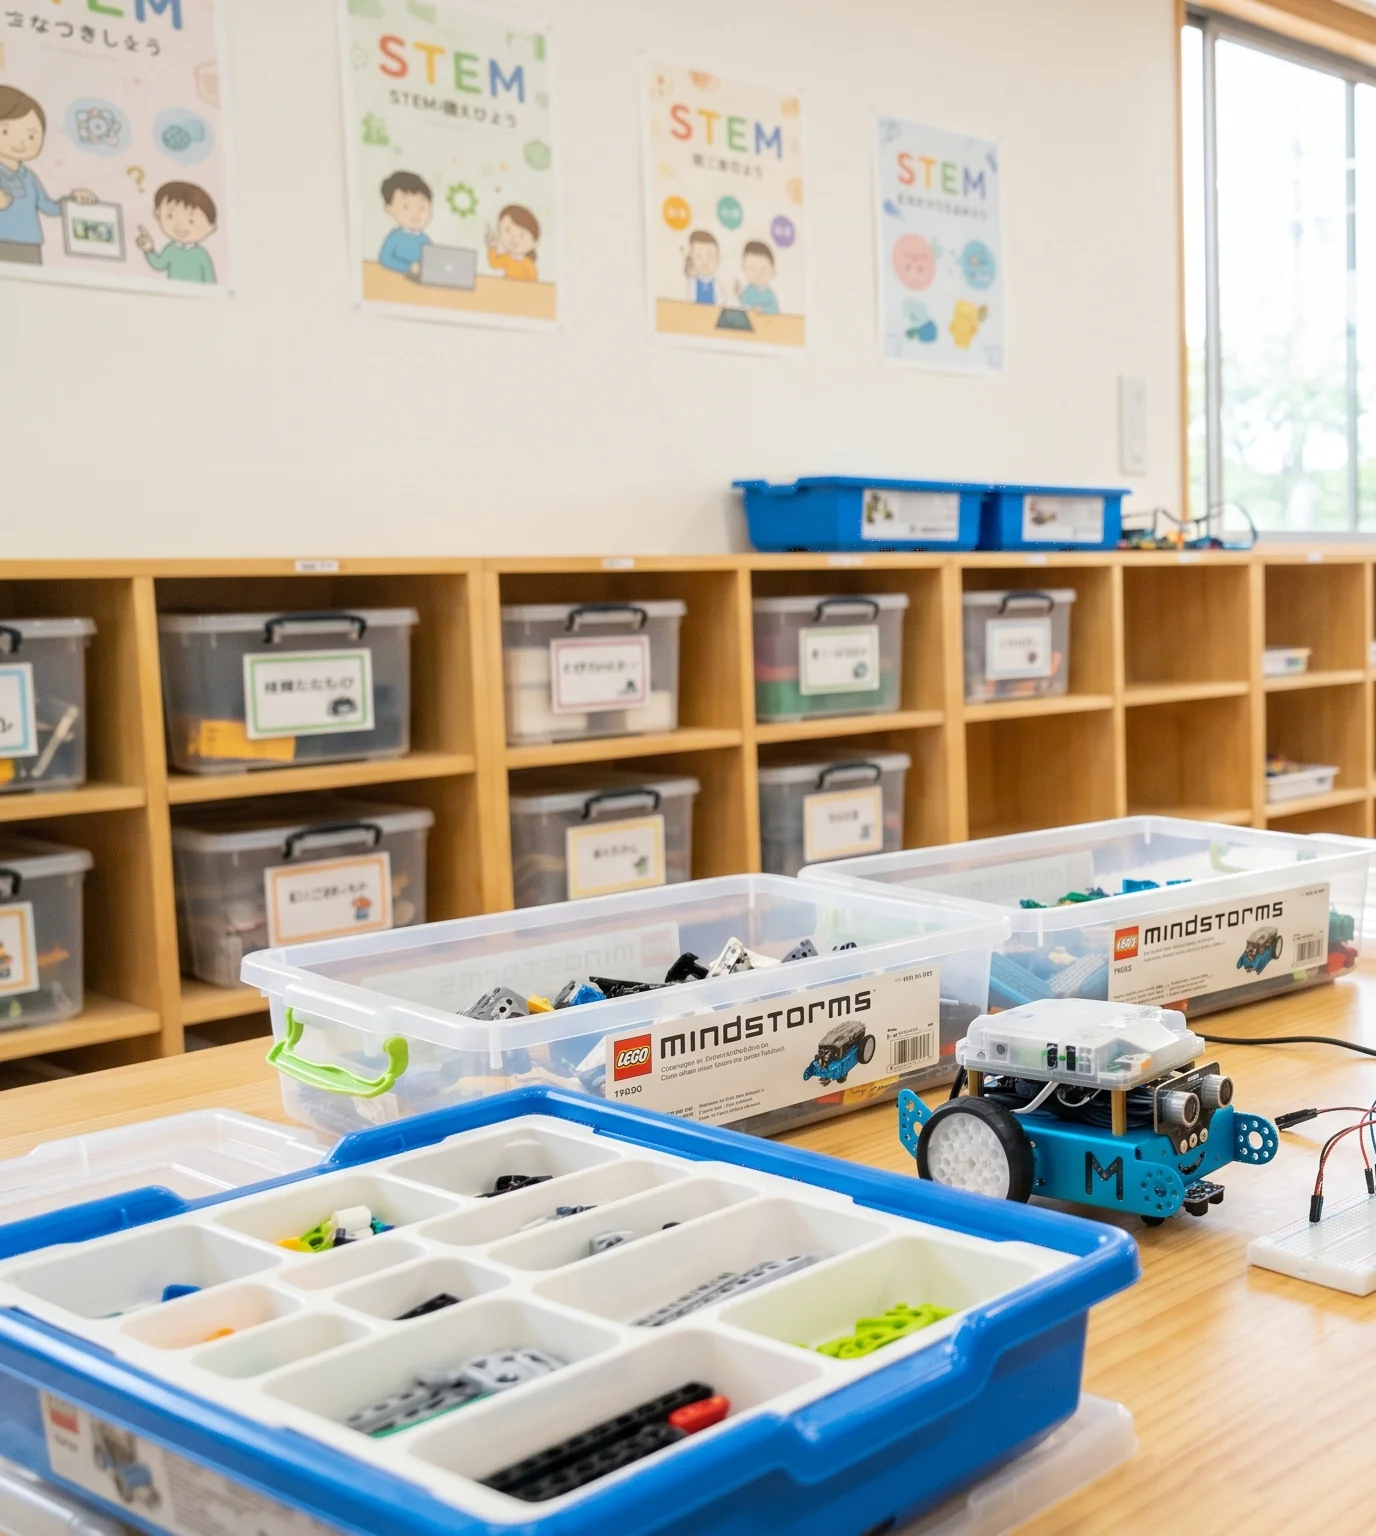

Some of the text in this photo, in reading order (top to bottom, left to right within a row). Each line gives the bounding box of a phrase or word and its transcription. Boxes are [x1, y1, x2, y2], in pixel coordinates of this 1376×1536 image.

[379, 34, 525, 104] STEM
[670, 103, 782, 161] STEM
[897, 152, 986, 201] STEM
[616, 1045, 650, 1068] LEGO
[1085, 1151, 1124, 1201] M
